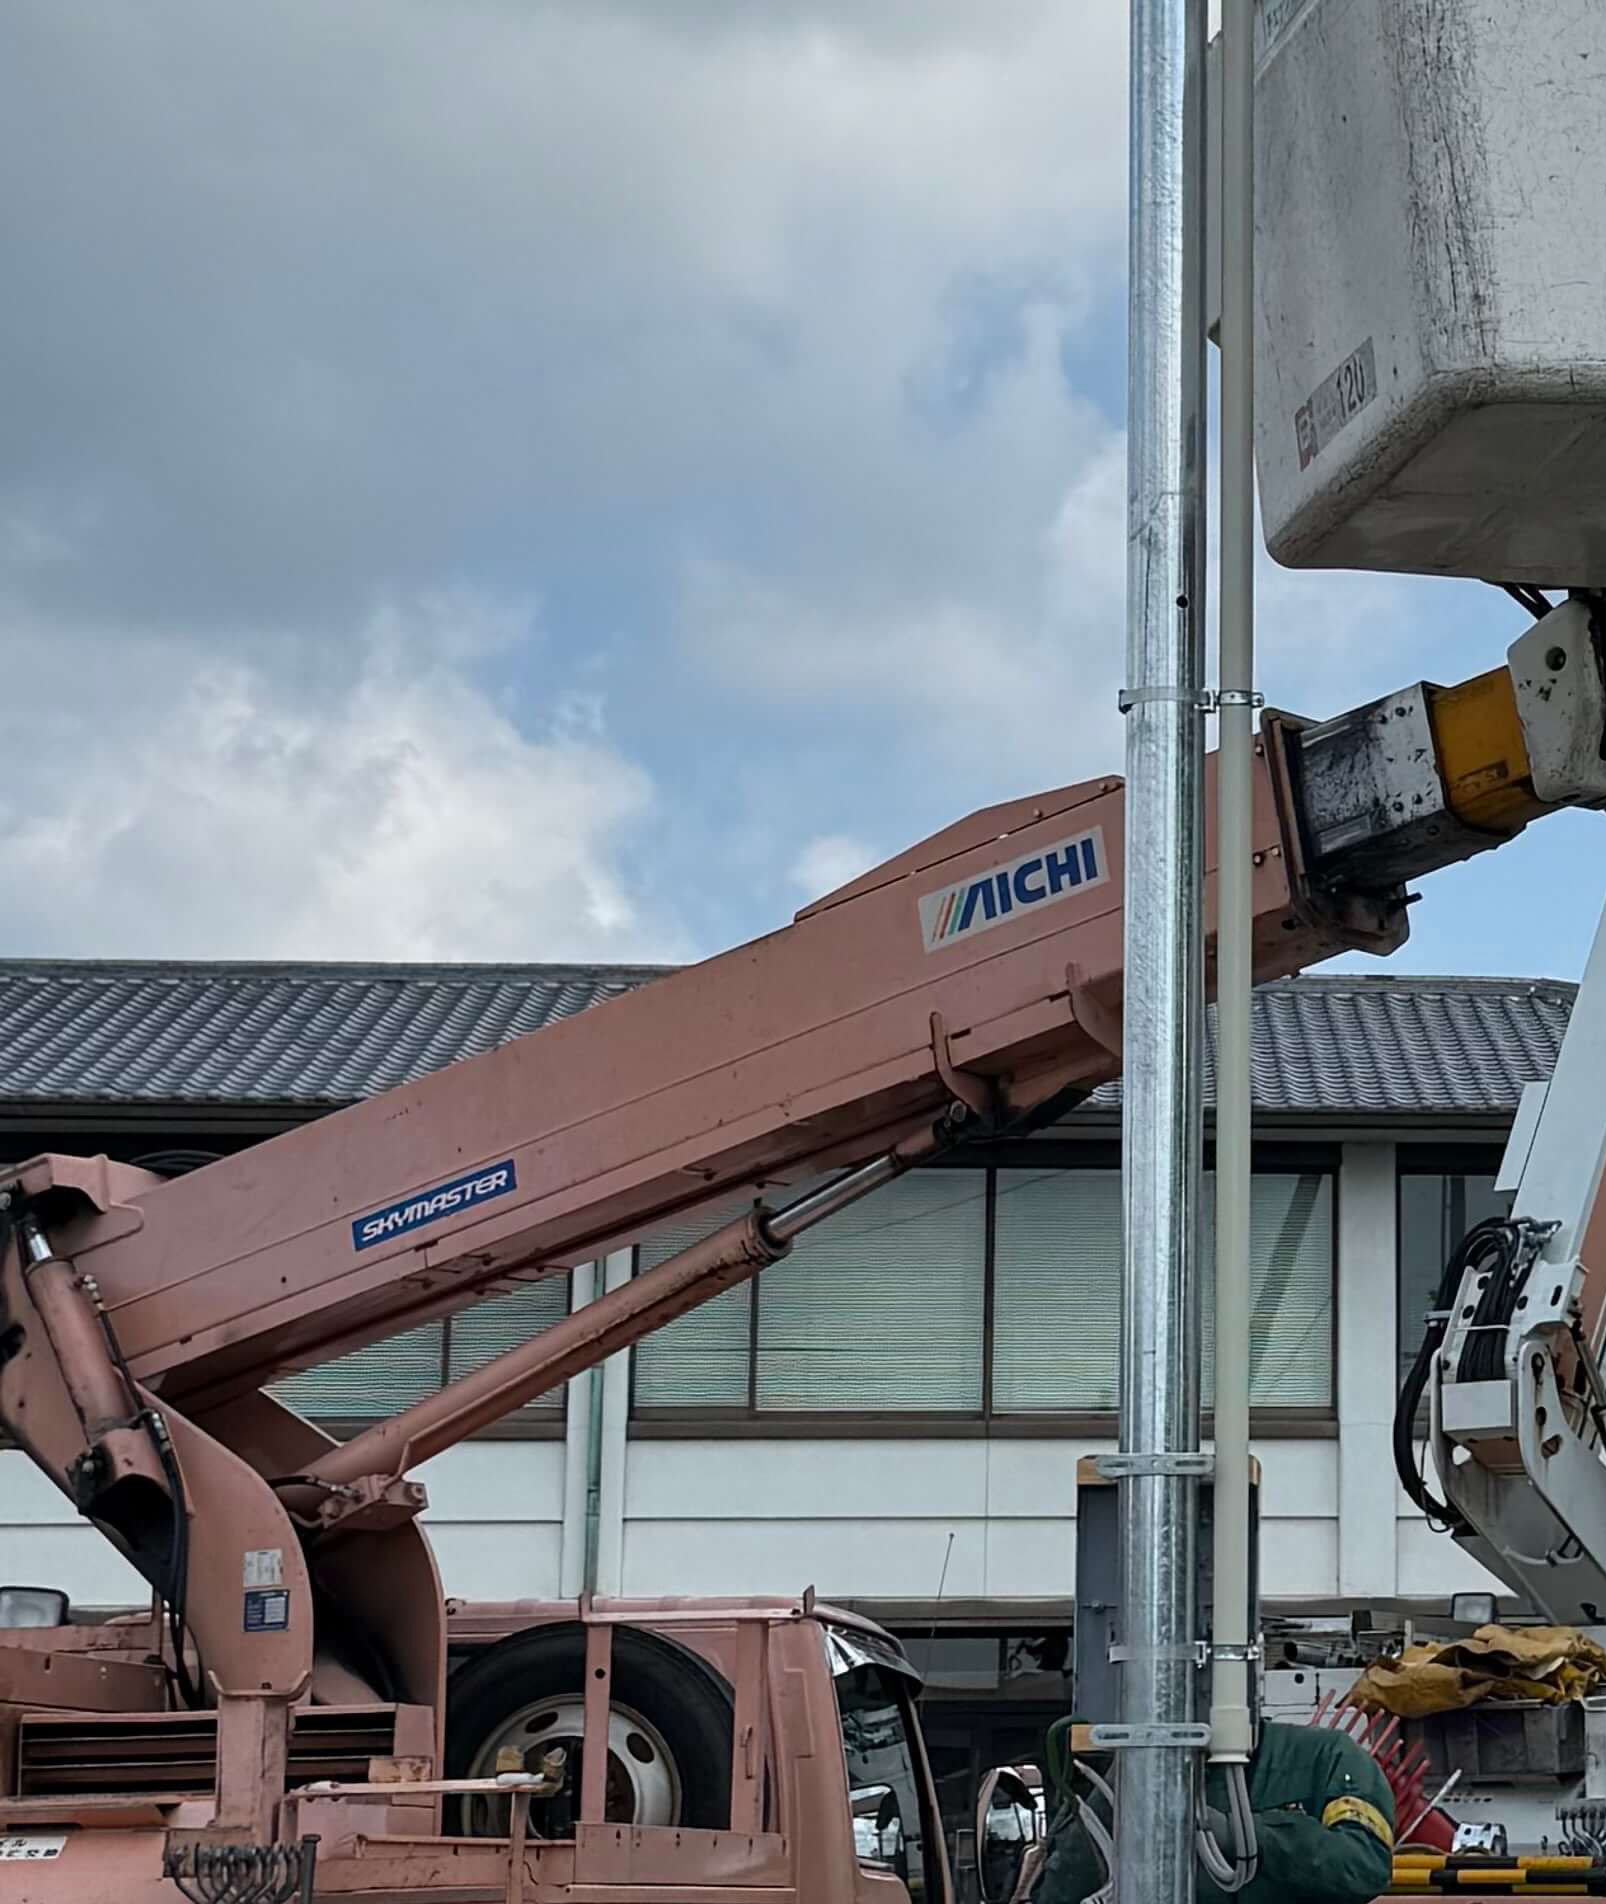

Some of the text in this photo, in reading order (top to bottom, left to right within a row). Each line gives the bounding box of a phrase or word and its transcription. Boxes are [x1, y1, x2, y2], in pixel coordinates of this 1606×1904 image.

[1336, 353, 1366, 420] 120
[957, 837, 1099, 933] AICHI
[361, 1169, 508, 1242] SKYMASTER
